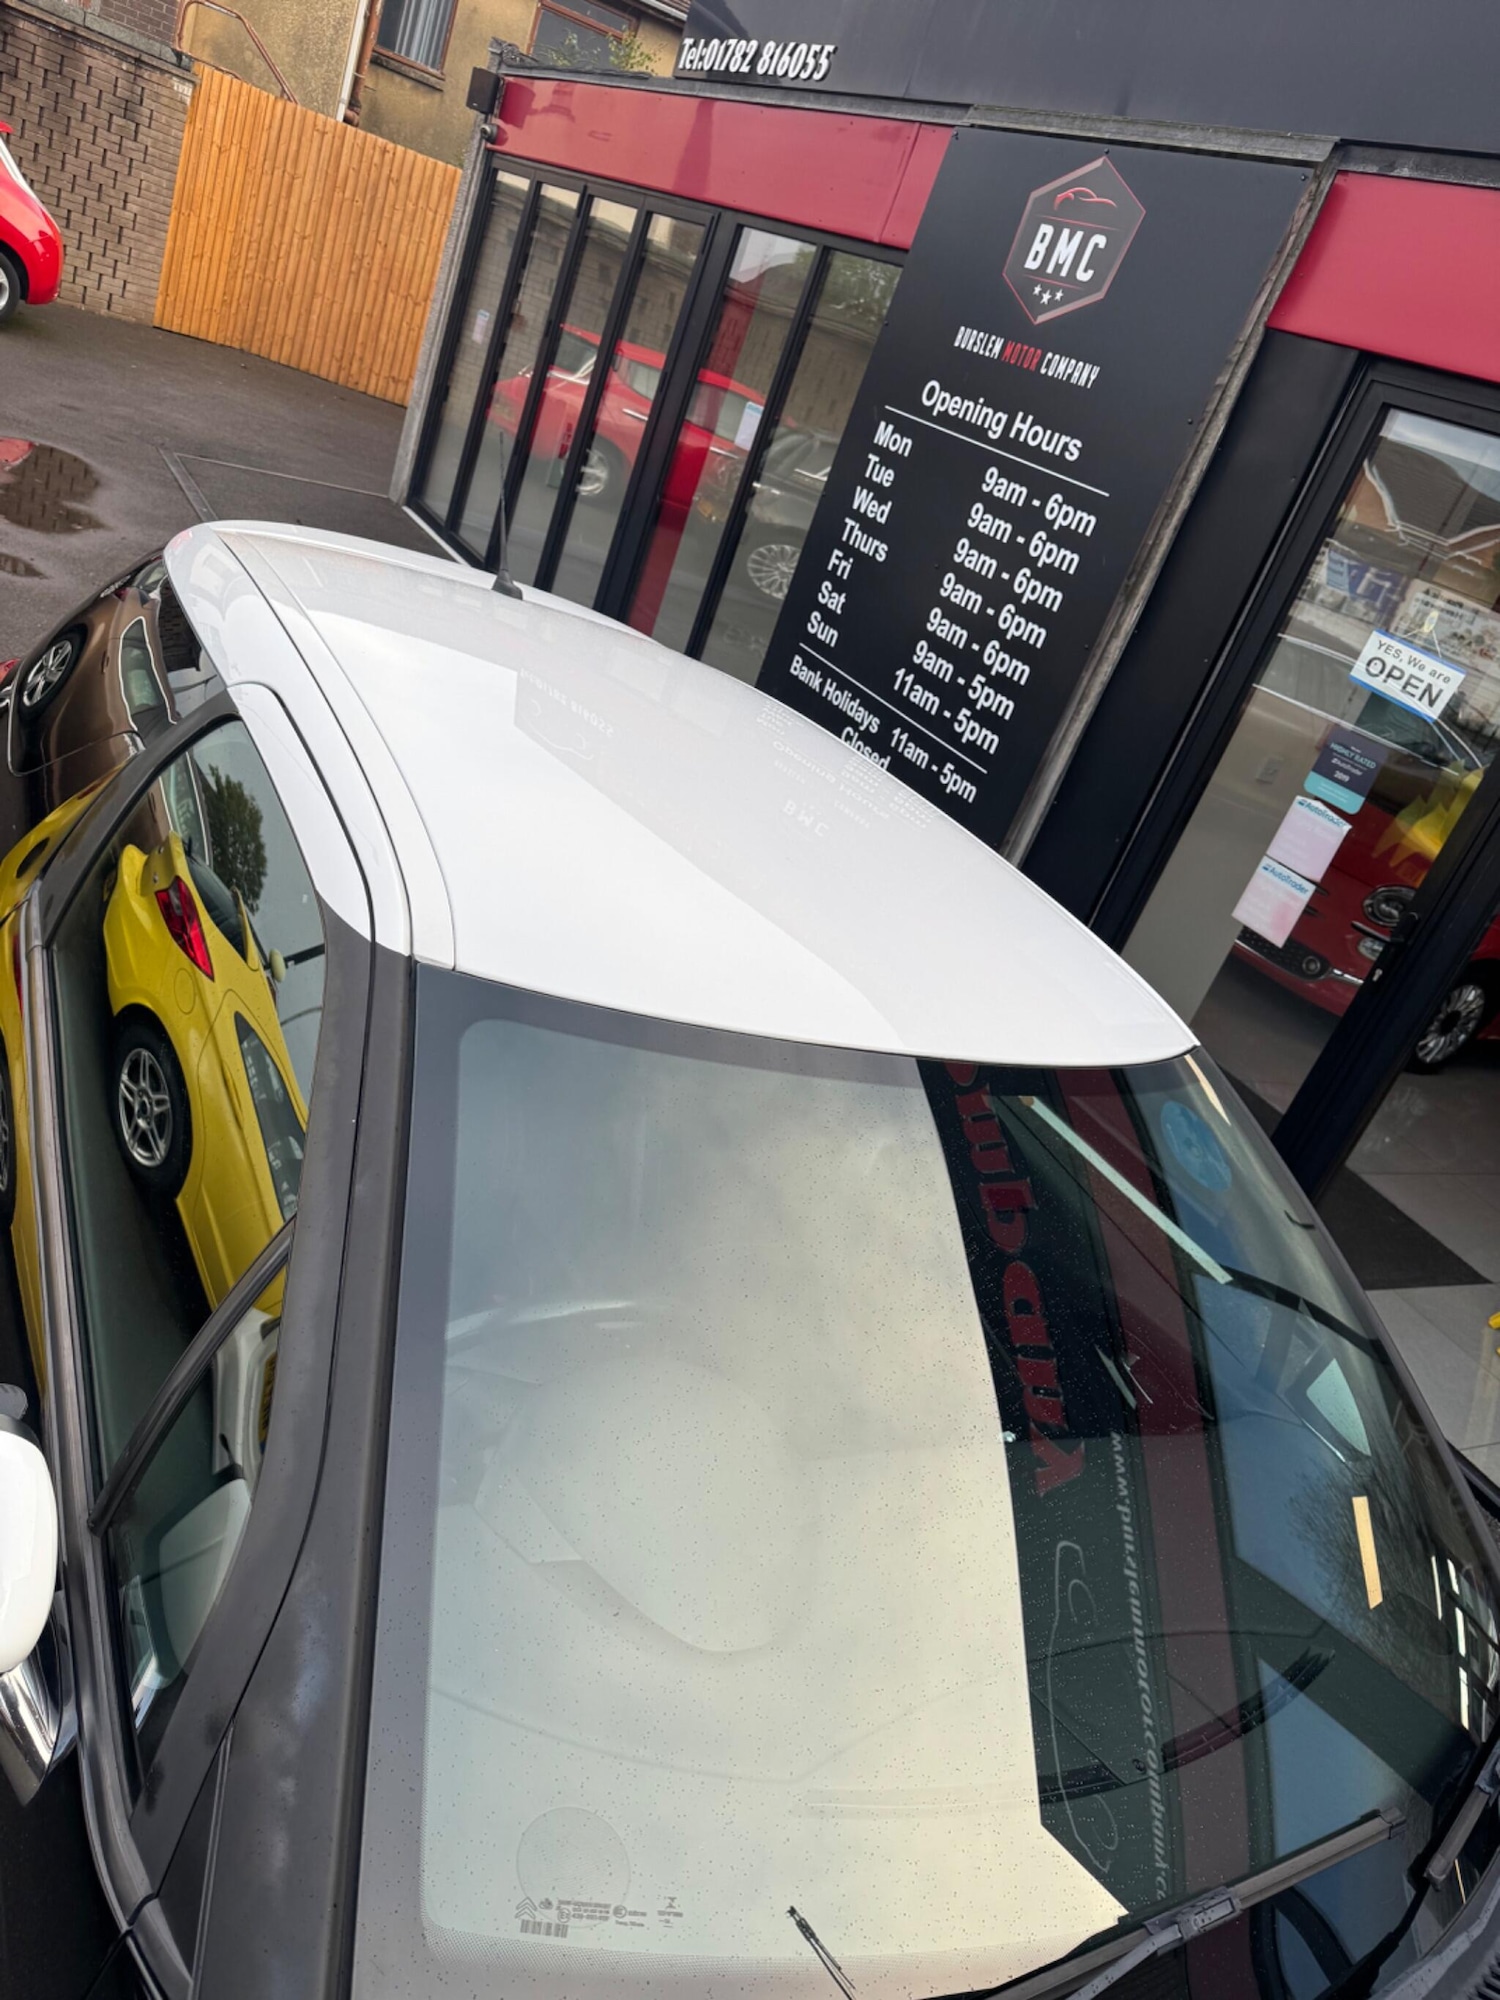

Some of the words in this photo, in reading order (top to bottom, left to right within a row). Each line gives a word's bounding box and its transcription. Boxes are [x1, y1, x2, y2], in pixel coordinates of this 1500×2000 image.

[678, 38, 759, 73] Tel:01782
[756, 40, 836, 81] 816055
[1024, 223, 1107, 282] BMC
[954, 326, 1005, 360] BURSLEM
[1001, 340, 1042, 371] MOTOR
[1040, 352, 1100, 389] COMPANY
[921, 380, 1009, 439] Opening
[1009, 411, 1083, 462] Hours
[864, 453, 895, 487] Tue
[967, 502, 1013, 543] 9am
[1016, 535, 1026, 544] -
[1028, 531, 1080, 575] 6pm
[873, 421, 913, 457] Mon
[981, 466, 1028, 507] 9am
[1031, 498, 1041, 507] -
[1044, 493, 1097, 537] 6pm
[841, 517, 889, 563] Thurs
[939, 572, 983, 614] 9am
[986, 607, 995, 616] -
[998, 603, 1047, 649] 6pm
[852, 485, 893, 524] Wed
[953, 537, 998, 579] 9am
[1001, 572, 1010, 581] -
[1013, 567, 1063, 612] 6pm
[818, 581, 846, 614] Sat
[912, 640, 954, 683] 9am
[957, 677, 966, 685] -
[967, 674, 1015, 721] 5pm
[827, 549, 854, 580] Fri
[926, 607, 968, 649] 9am
[971, 642, 980, 651] -
[982, 640, 1031, 686] 6pm
[1377, 640, 1403, 663] YES,
[1407, 655, 1425, 672] We
[1429, 669, 1451, 684] are
[789, 655, 823, 692] Bank
[822, 678, 881, 734] Holidays
[890, 727, 929, 770] 11am
[939, 763, 978, 803] 5pm
[807, 611, 839, 648] Sun
[893, 668, 940, 716] 11am
[943, 710, 951, 719] -
[953, 708, 1000, 755] 5pm
[1365, 656, 1444, 708] OPEN
[841, 726, 891, 770] Closed
[1269, 867, 1309, 894] AutoTrader
